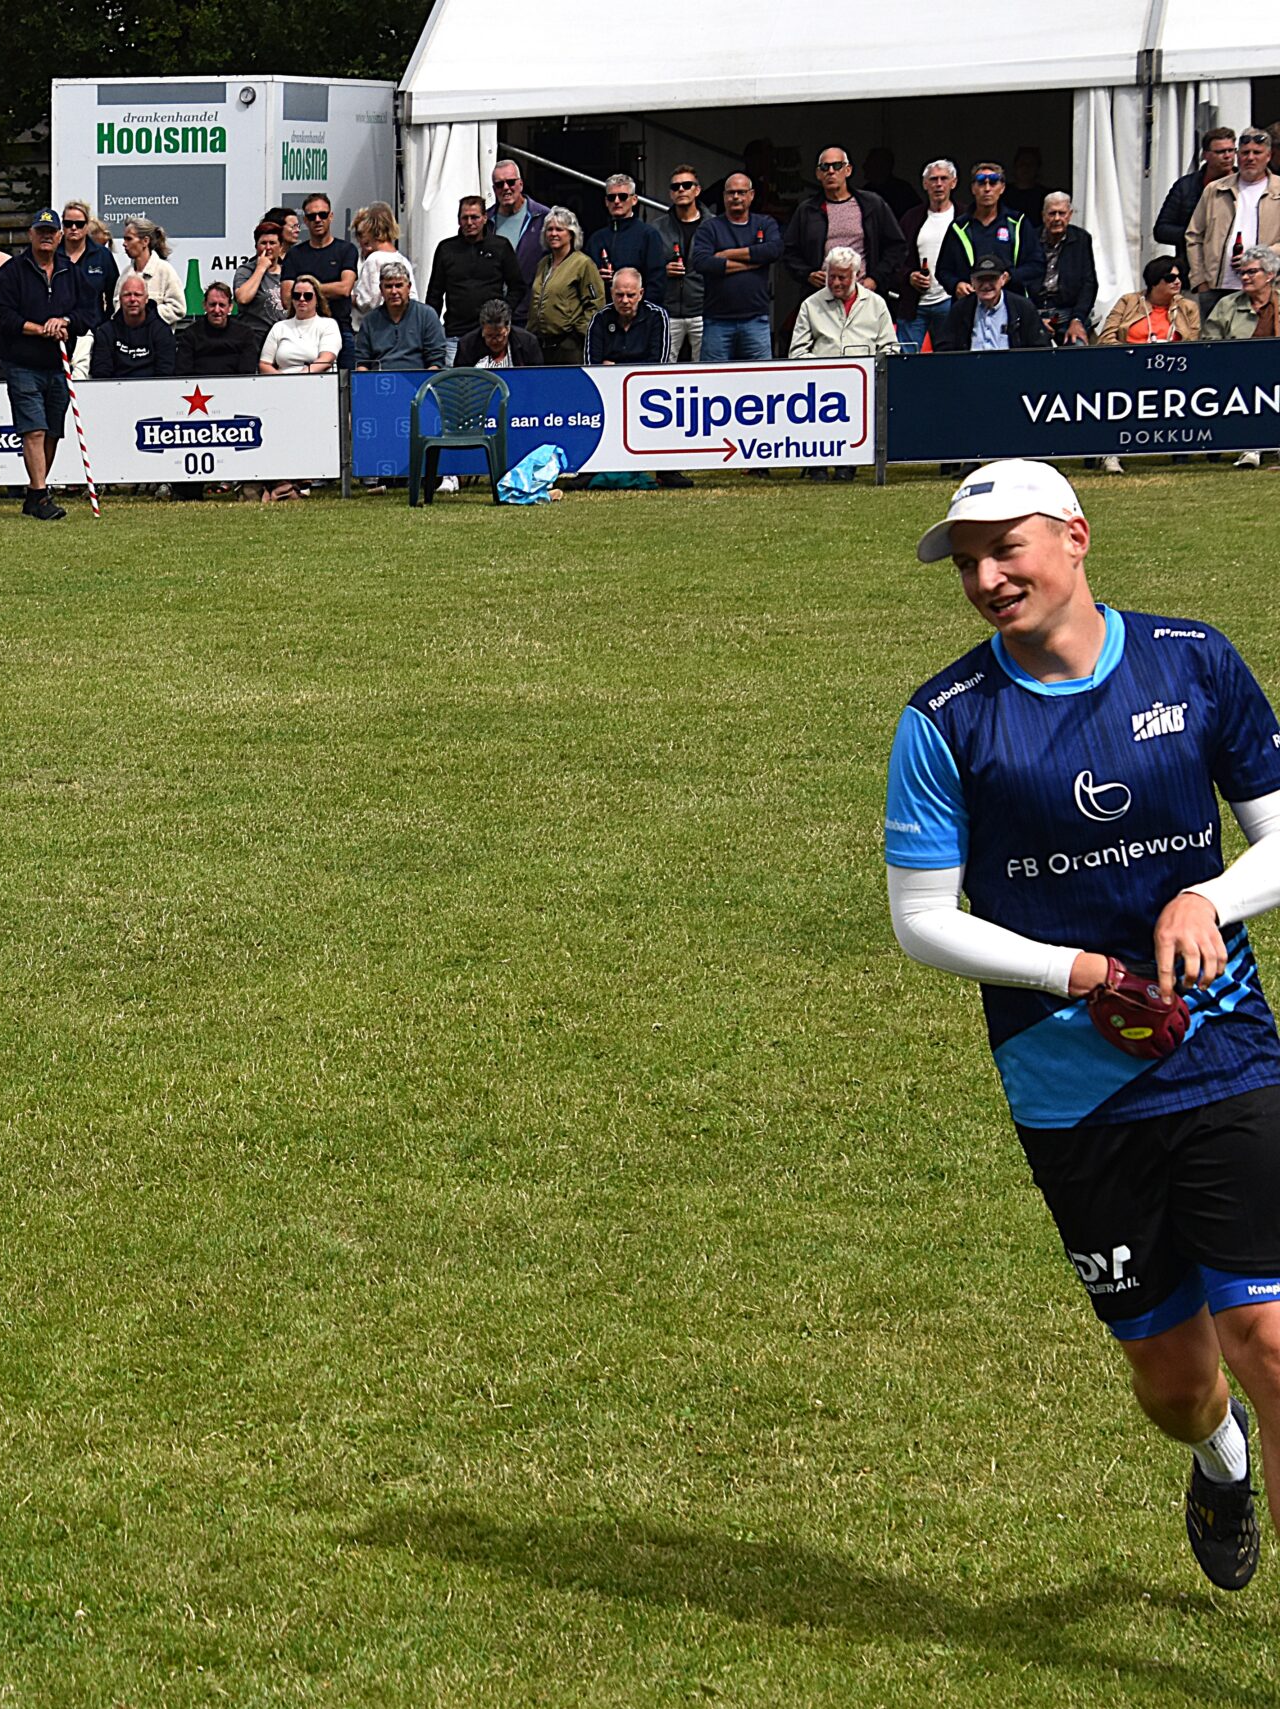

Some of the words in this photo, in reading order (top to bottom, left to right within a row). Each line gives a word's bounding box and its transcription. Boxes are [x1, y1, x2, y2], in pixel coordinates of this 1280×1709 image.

[123, 111, 219, 123] drankenhandel
[97, 122, 227, 154] Hooisma
[282, 141, 328, 181] Hooisma
[104, 194, 180, 206] Evenementen
[104, 211, 146, 224] support
[1146, 353, 1188, 371] 1873
[639, 382, 851, 438] Sijperda
[1021, 384, 1280, 423] VANDERGAN
[511, 416, 539, 428] aan
[544, 413, 563, 427] de
[567, 412, 601, 429] slag
[142, 423, 256, 445] Heineken
[1120, 428, 1213, 445] DOKKUM
[738, 436, 847, 460] Verhuur
[184, 452, 215, 475] 0.0
[928, 671, 985, 711] Rabobank
[1007, 857, 1039, 878] FB
[1048, 822, 1214, 875] Oranjewoud
